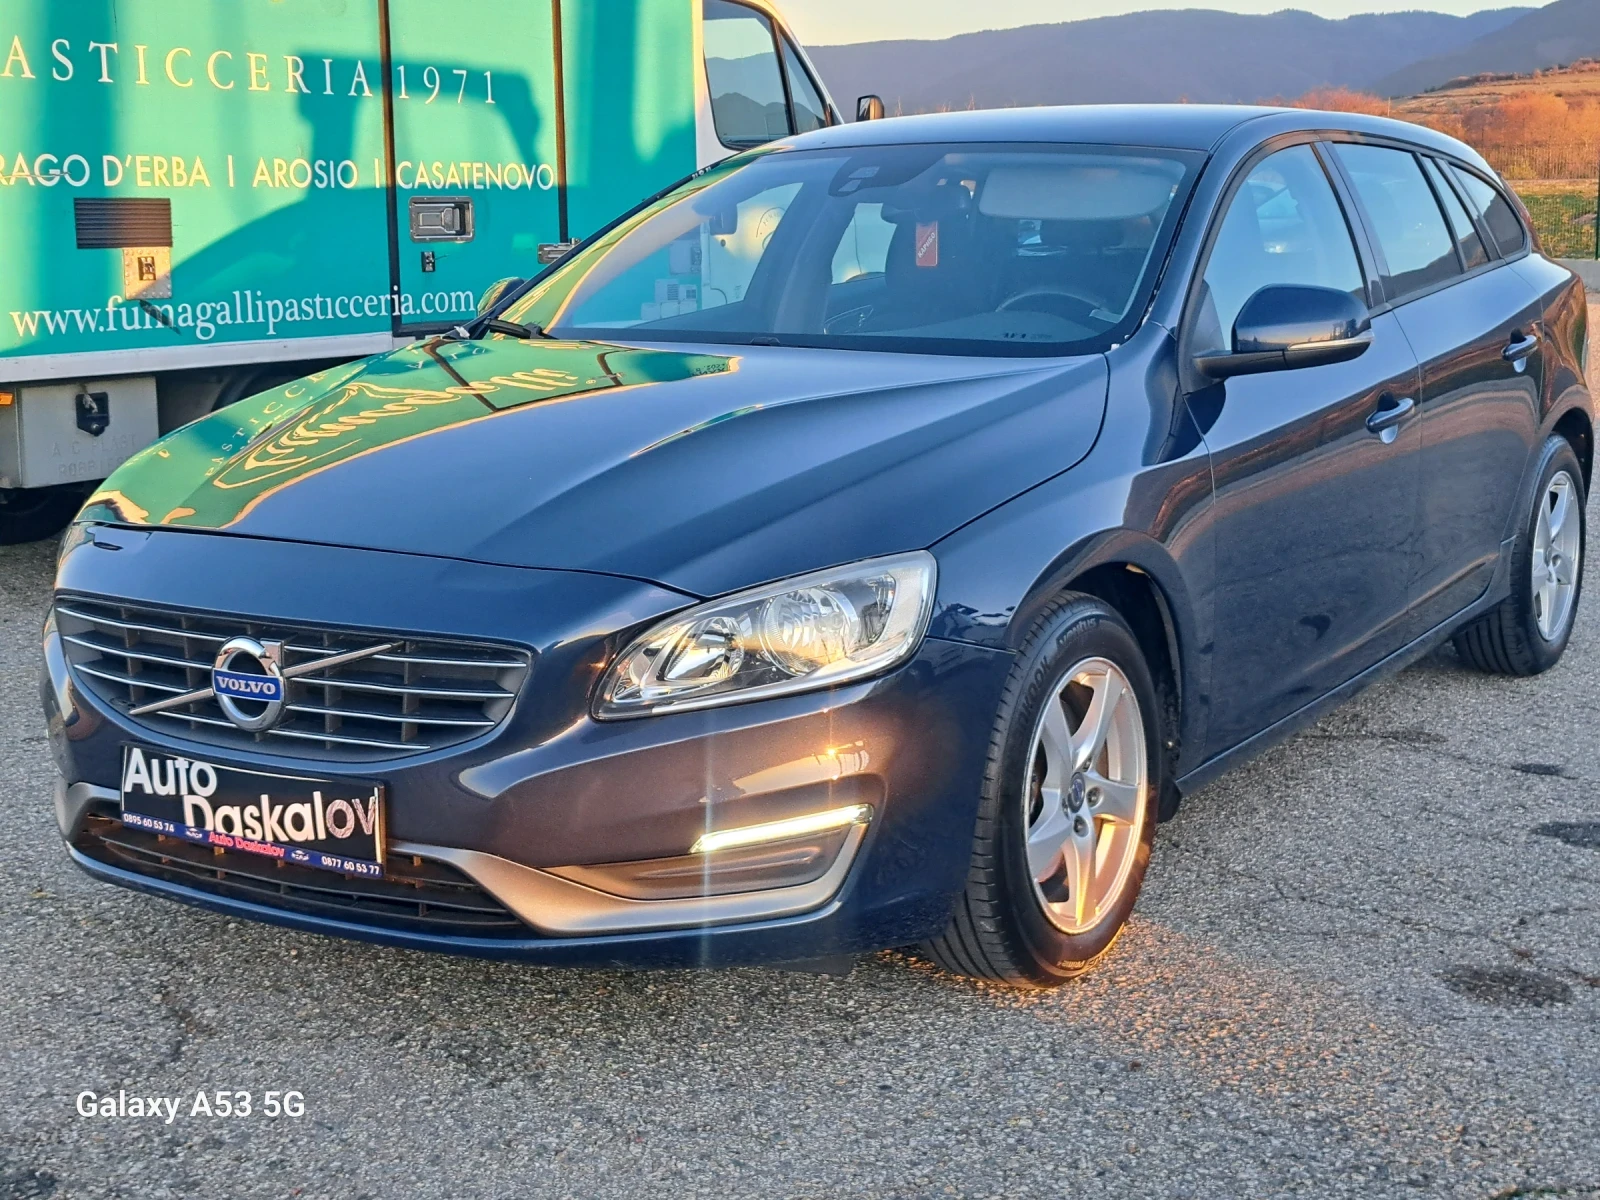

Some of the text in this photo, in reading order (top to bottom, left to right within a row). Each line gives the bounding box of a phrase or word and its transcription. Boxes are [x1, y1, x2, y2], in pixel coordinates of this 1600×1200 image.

[0, 34, 496, 105] ASTICCERIA 1971
[102, 154, 211, 188] D'ERBA
[252, 156, 359, 189] AROSIO
[395, 160, 555, 191] CASATENOVO
[8, 285, 477, 341] www.fumagallipasticceria.com
[216, 675, 276, 695] VOLVO
[124, 747, 217, 796] Auto
[123, 813, 175, 833] 0895 60 53 74
[183, 790, 377, 843] Daskalov
[208, 831, 285, 857] Auto Daskalov
[321, 855, 380, 875] 0877 60 53 77
